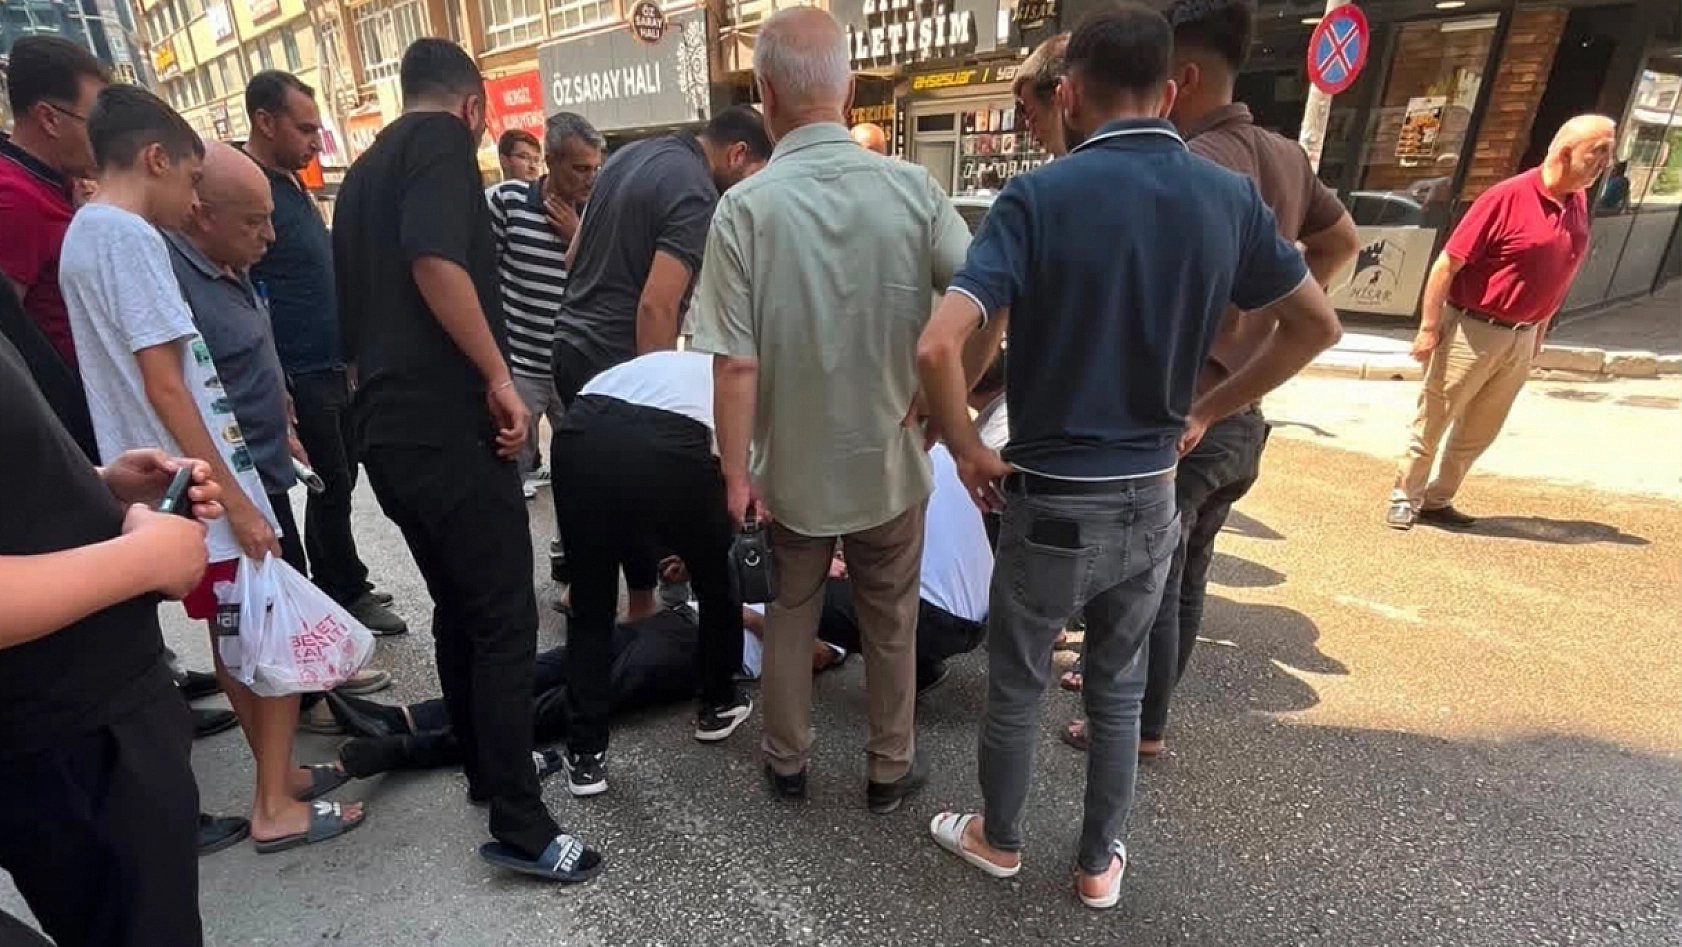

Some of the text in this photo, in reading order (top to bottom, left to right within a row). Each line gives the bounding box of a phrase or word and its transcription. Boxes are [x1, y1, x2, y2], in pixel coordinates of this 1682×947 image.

[642, 4, 655, 16] ÖZ
[635, 16, 662, 29] SARAY
[640, 27, 660, 40] HALI
[553, 61, 661, 106] ÖZ SARAY HALI
